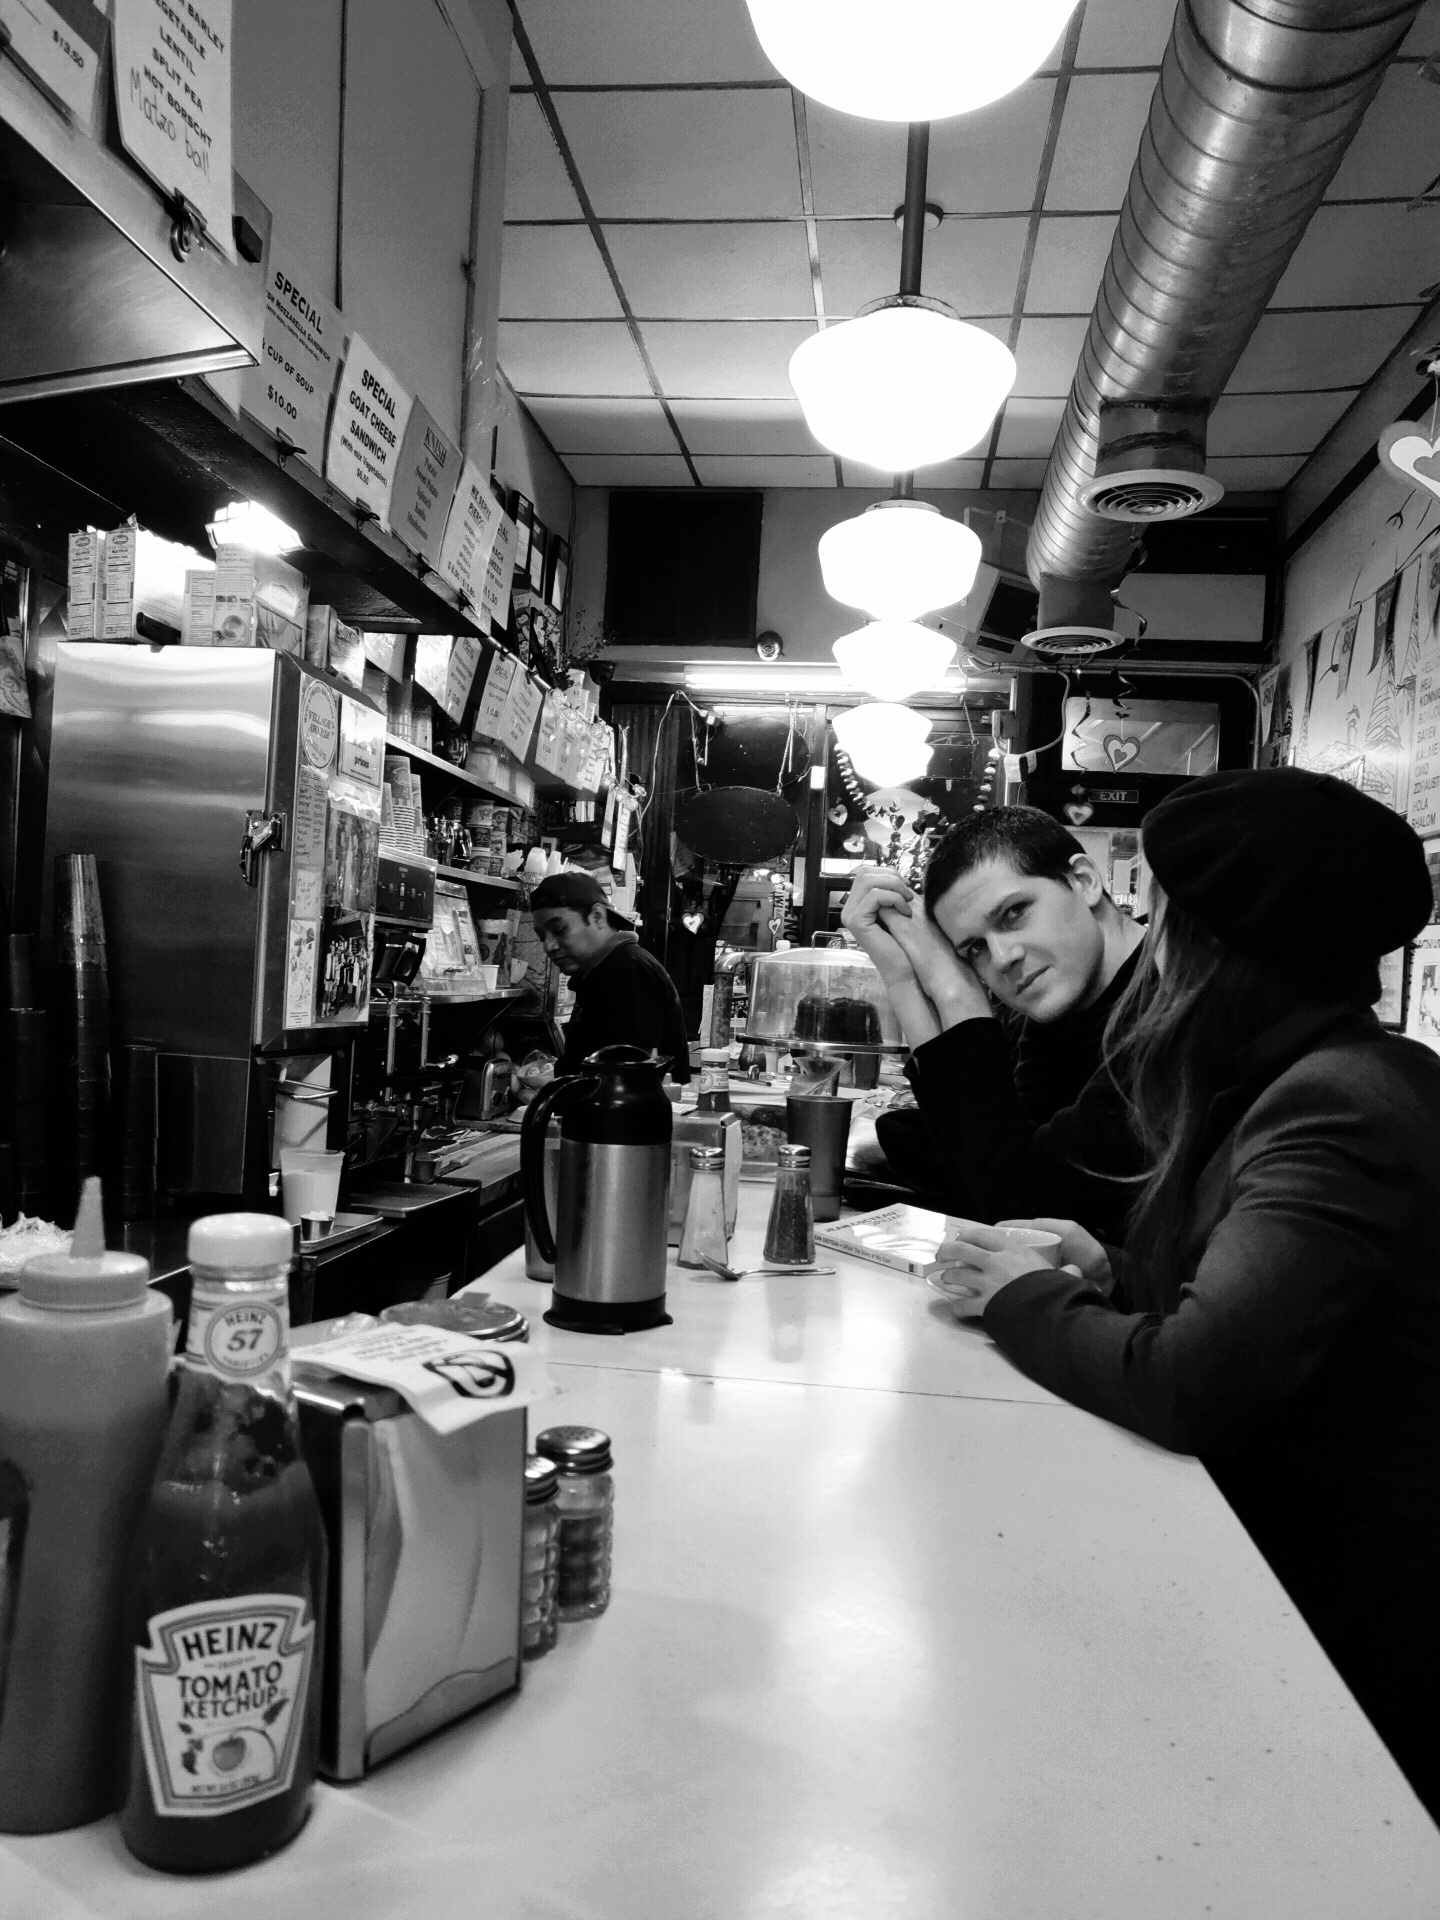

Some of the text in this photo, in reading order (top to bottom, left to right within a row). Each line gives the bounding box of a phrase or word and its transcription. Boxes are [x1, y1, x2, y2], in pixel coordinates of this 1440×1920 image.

[52, 30, 84, 68] $13.50
[160, 25, 195, 76] LENTIL
[187, 3, 224, 53] BARLEY
[152, 47, 203, 112] SPLIT PEA
[130, 66, 210, 183] Matzo ball
[144, 64, 212, 148] HOT BORSCHT
[274, 271, 323, 335] SPECIAL
[267, 345, 314, 394] CUP OF SOUP
[267, 384, 297, 420] $10.00
[361, 369, 396, 419] SPECIAL
[349, 390, 397, 448] GOAT CHEESE
[350, 420, 387, 464] SANDWICH
[1099, 791, 1128, 801] EXIT
[226, 1311, 268, 1327] HEINZ
[227, 1328, 263, 1351] 57
[181, 1622, 278, 1661] HEINZ
[177, 1661, 283, 1698] TOMATO
[183, 1685, 278, 1719] KETCHUP
